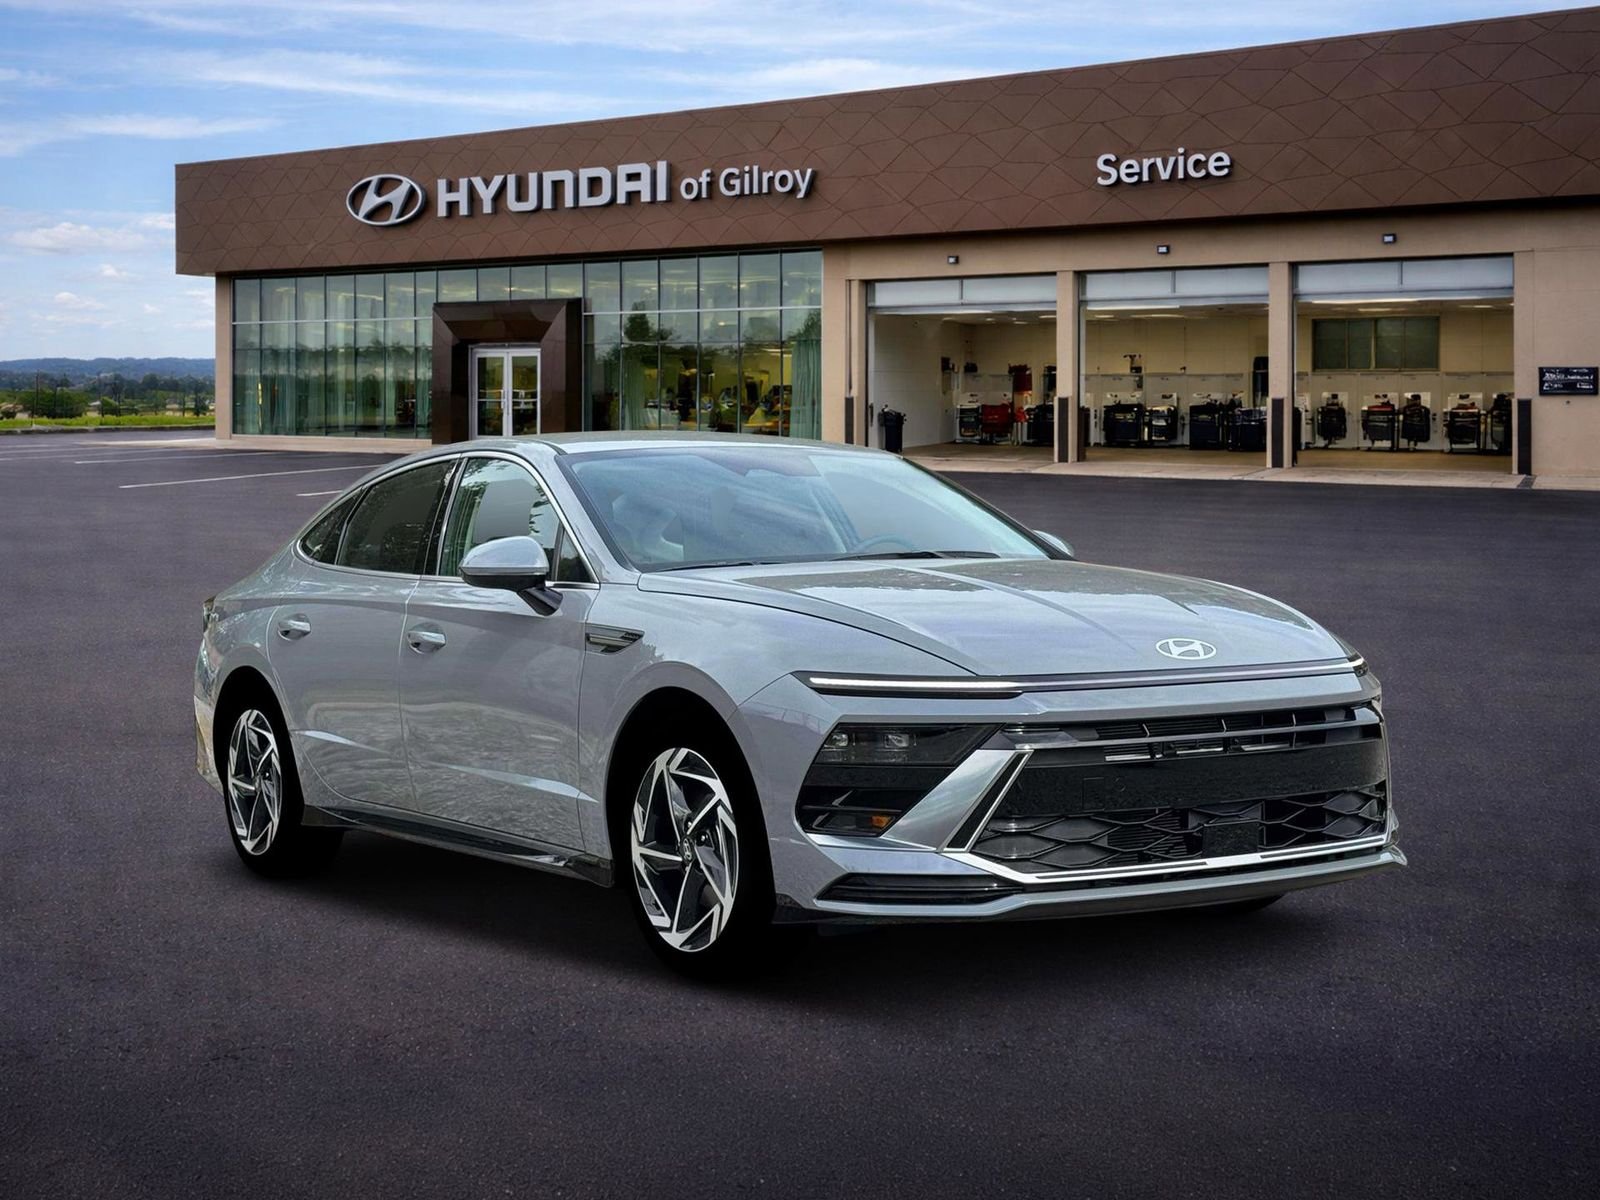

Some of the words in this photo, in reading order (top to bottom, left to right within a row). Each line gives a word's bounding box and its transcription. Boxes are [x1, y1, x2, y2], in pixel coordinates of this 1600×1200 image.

[436, 160, 668, 217] HYUNDAI
[680, 168, 711, 200] of
[719, 165, 813, 199] Gilroy
[1096, 147, 1231, 186] Service
